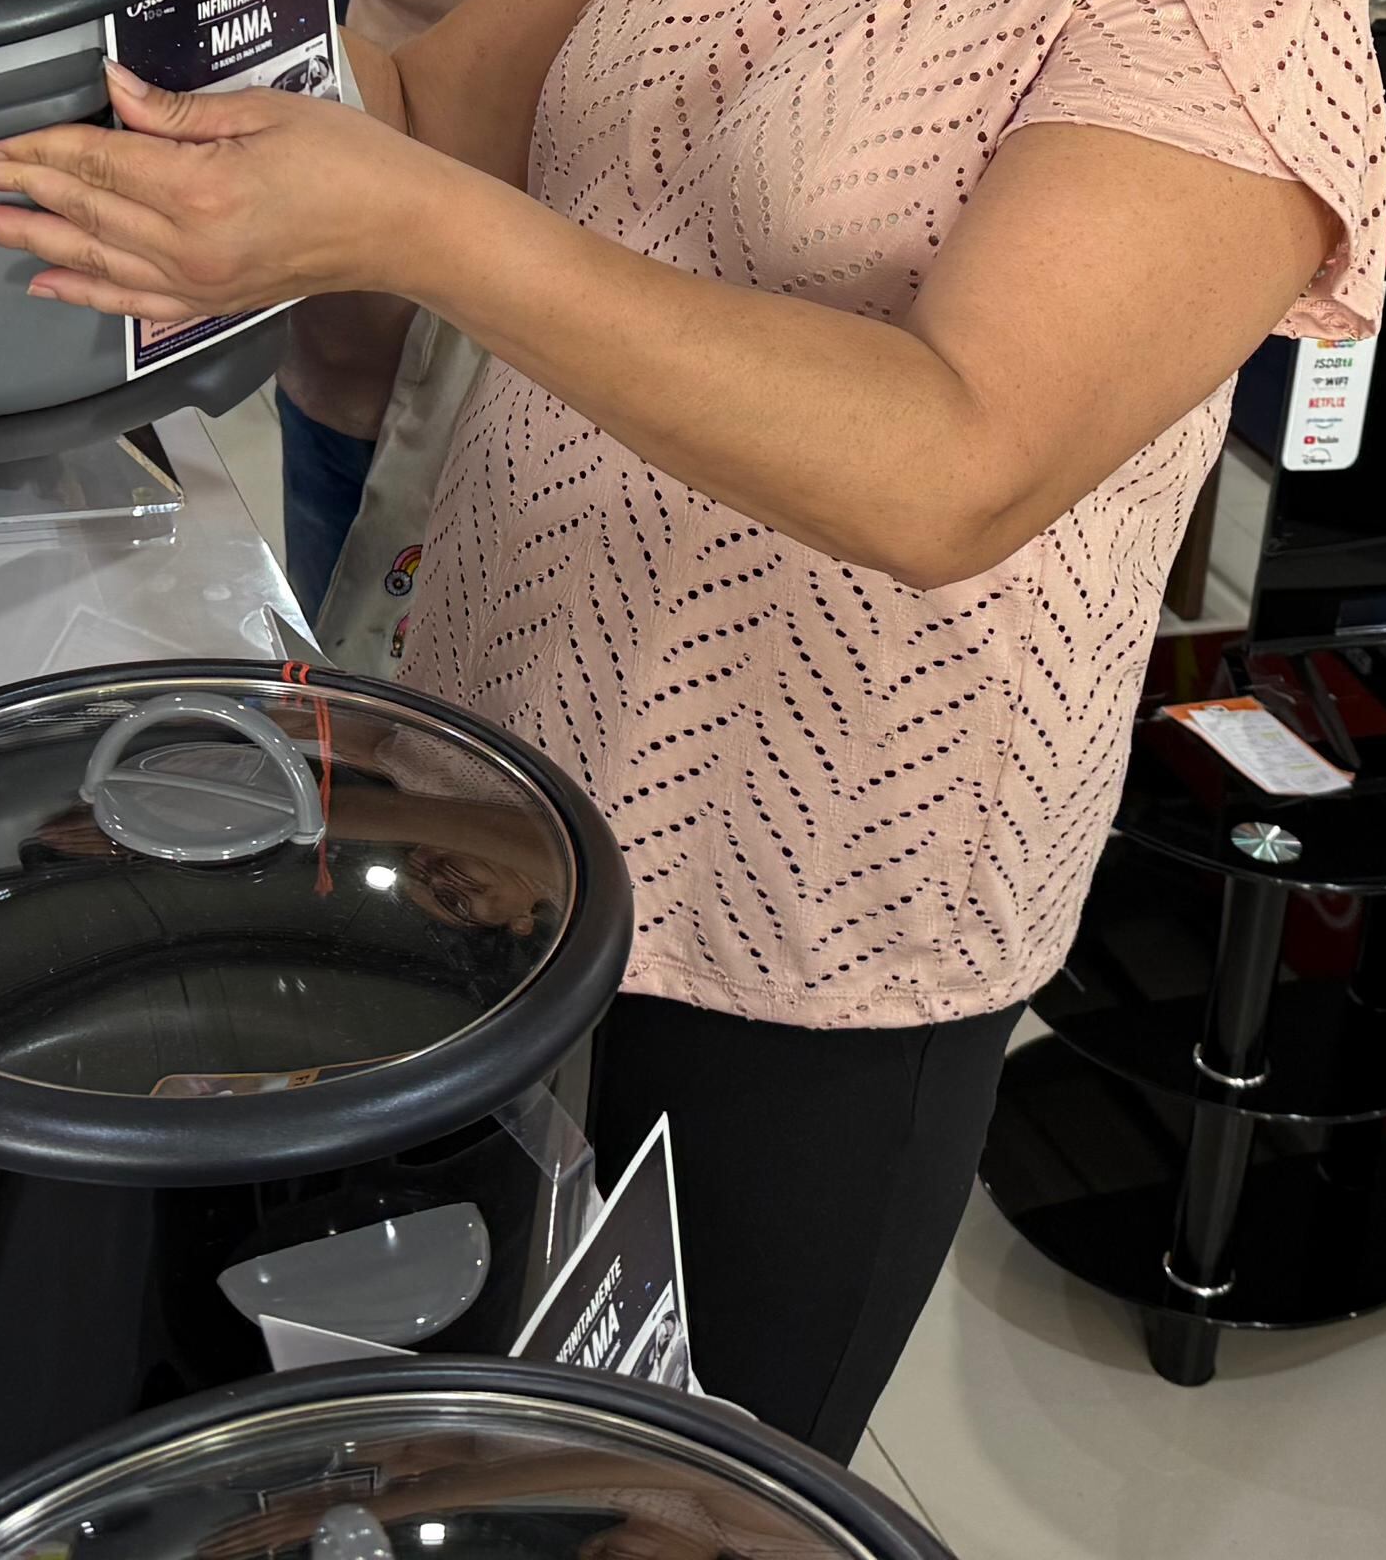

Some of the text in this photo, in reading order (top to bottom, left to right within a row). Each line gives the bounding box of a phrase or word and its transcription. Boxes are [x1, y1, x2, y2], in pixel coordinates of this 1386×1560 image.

[1307, 396, 1347, 409] NETFLIX
[555, 1254, 623, 1364] NFINITAMENTE
[574, 1292, 621, 1369] AMÁ
